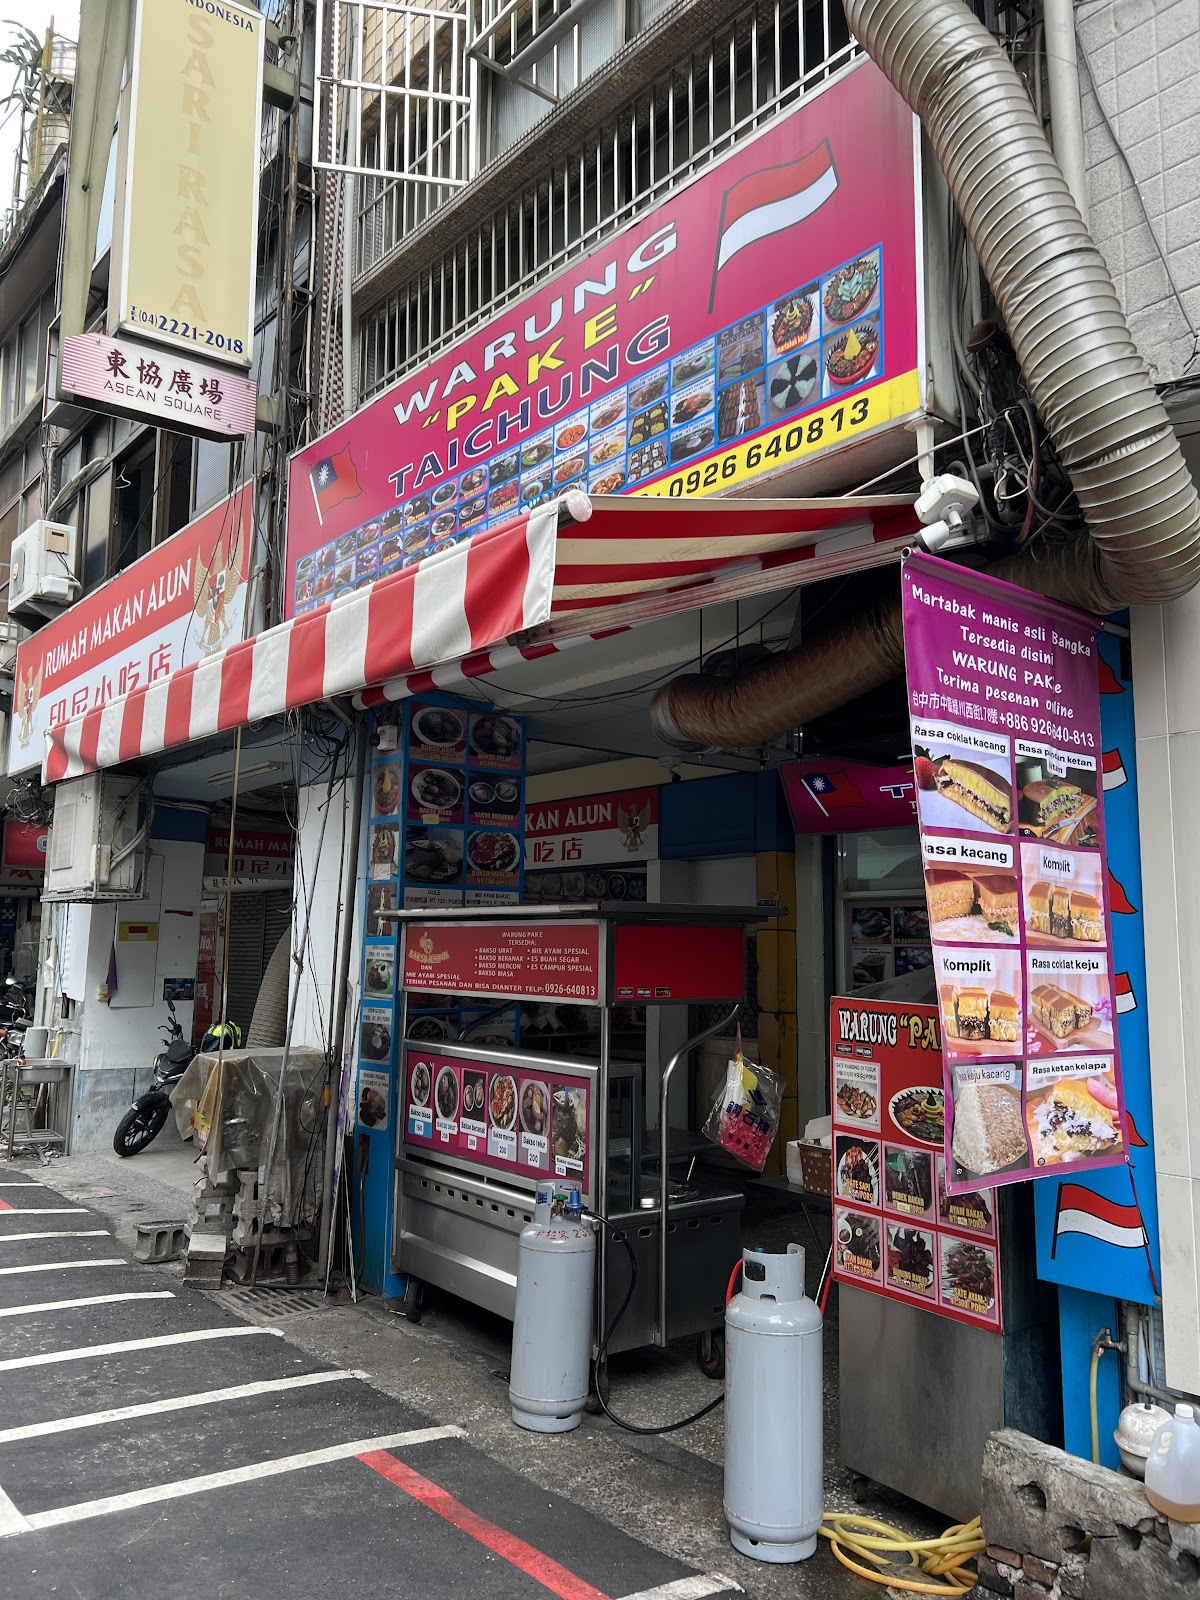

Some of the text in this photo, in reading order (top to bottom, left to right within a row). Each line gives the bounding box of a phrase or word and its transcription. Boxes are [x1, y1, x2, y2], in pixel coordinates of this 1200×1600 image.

[392, 220, 678, 426] WARUNG
[105, 348, 225, 405] 東協廣場
[103, 380, 222, 421] ASEAN SQUARE
[388, 313, 671, 498] TAICHUNG
[745, 397, 870, 469] 640813
[44, 558, 193, 679] RUMAH MAKAN ALUN
[912, 584, 1091, 657] Martabak manis asli Bangka
[960, 625, 1054, 666] Tersedia disini
[952, 650, 1018, 682] WARUNG
[936, 666, 979, 694] Terima
[985, 684, 1039, 708] pesenan
[999, 712, 1029, 731] +886
[914, 724, 1006, 754] Rasa coklat kacang
[1018, 742, 1093, 768] Rasa ketan
[564, 802, 612, 827] ALUN
[924, 841, 1007, 864] asa kacang
[539, 964, 566, 972] CAMPUR
[943, 957, 992, 976] Komplit
[1032, 957, 1051, 970] Rasa
[1075, 958, 1099, 971] keju
[405, 978, 427, 986] TERIMA
[491, 983, 522, 991] DIANTER
[837, 1008, 898, 1046] WARUNG
[981, 1068, 1011, 1081] kacang
[1032, 1064, 1051, 1075] Rasa
[529, 1153, 539, 1163] 200
[949, 1205, 985, 1220] AYAM BAKAR
[856, 1255, 873, 1269] BAKAR
[953, 1286, 968, 1299] SATE
